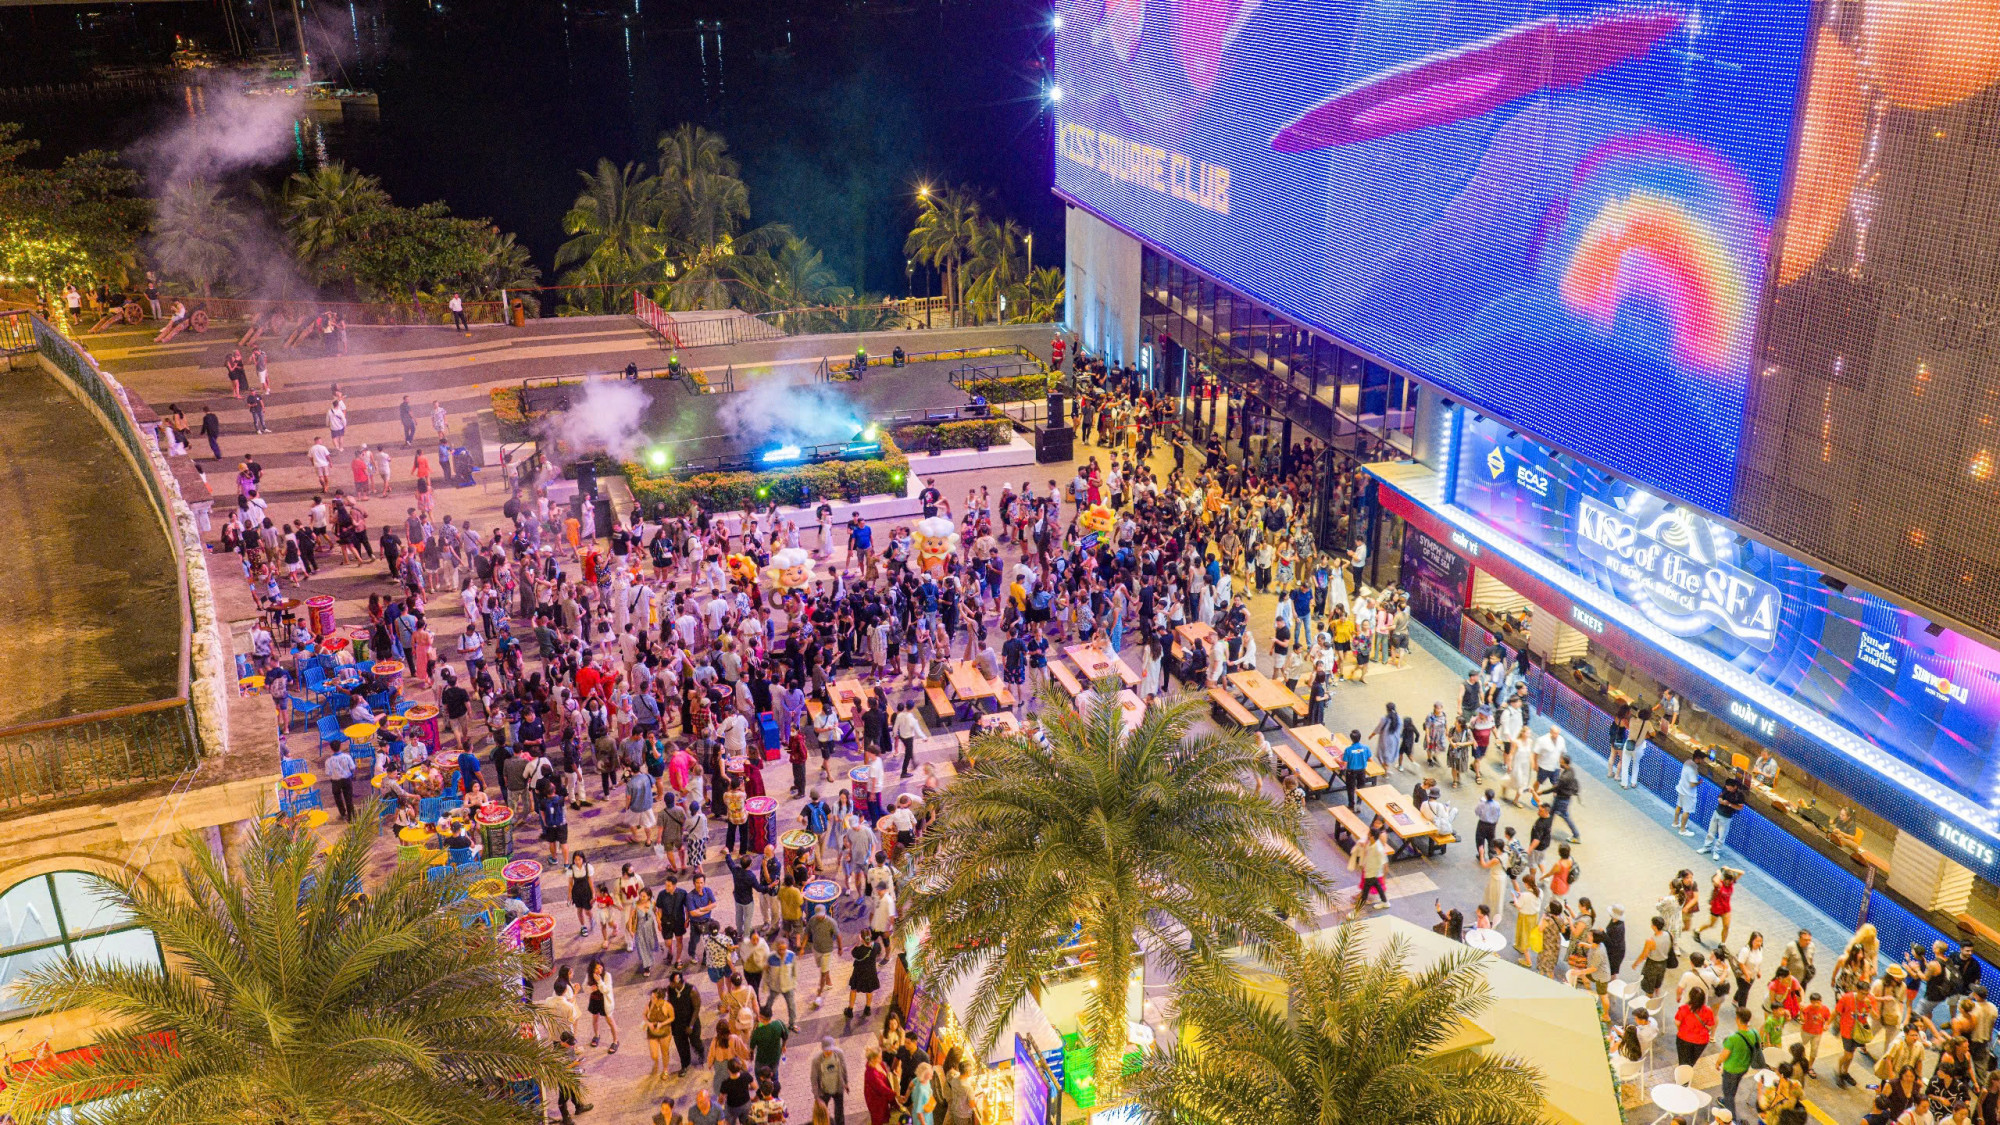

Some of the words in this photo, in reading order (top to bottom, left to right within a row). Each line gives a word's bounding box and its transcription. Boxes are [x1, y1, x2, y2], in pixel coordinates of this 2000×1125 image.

[1099, 130, 1166, 194] SQUARE
[1170, 151, 1230, 215] CLUB
[1517, 465, 1549, 492] ECA2
[1419, 535, 1456, 565] SYMPHONY
[1422, 547, 1431, 557] OF
[1430, 552, 1441, 564] THE
[1440, 558, 1450, 571] SEA
[1578, 501, 1637, 559] KISS
[1635, 544, 1661, 572] of
[1662, 552, 1701, 594] the
[1702, 568, 1775, 633] SEA
[1572, 606, 1605, 633] TICKETS
[1861, 631, 1879, 647] Sun
[1857, 649, 1881, 669] Land
[1859, 640, 1898, 667] Paradise
[1760, 717, 1776, 737] VÉ
[1938, 821, 1994, 865] TICKETS
